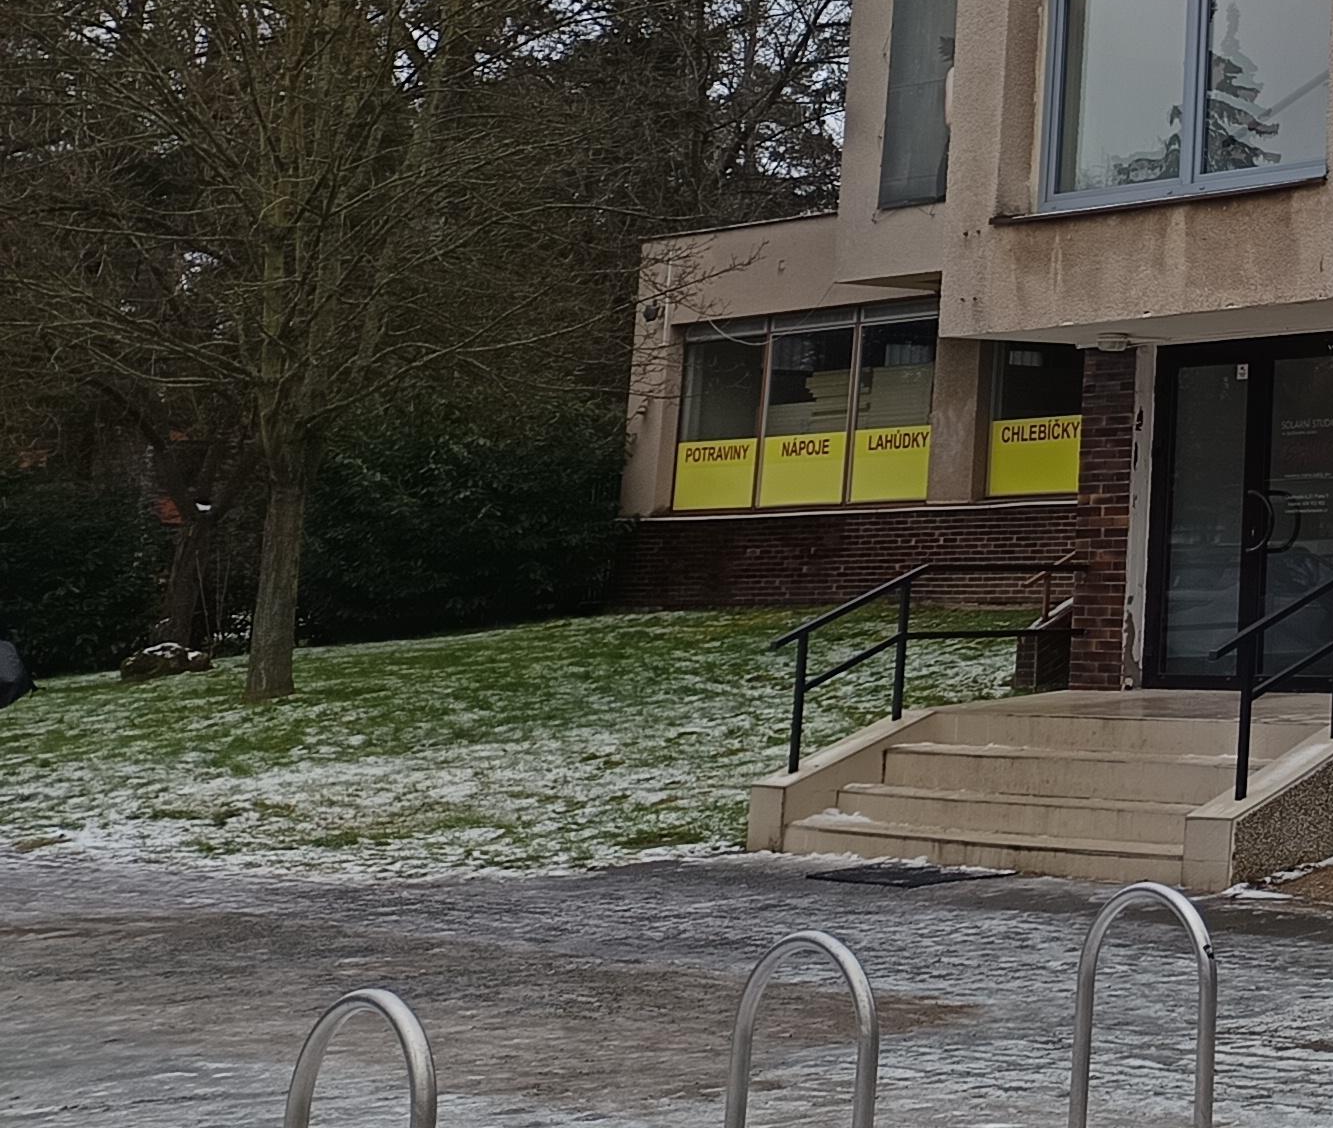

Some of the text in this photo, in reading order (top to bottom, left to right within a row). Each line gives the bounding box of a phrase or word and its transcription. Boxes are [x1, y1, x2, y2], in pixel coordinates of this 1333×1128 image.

[1001, 419, 1081, 444] CHLEBÍČKY
[685, 444, 750, 463] POTRAVINY
[781, 438, 830, 457] NÁPOJE
